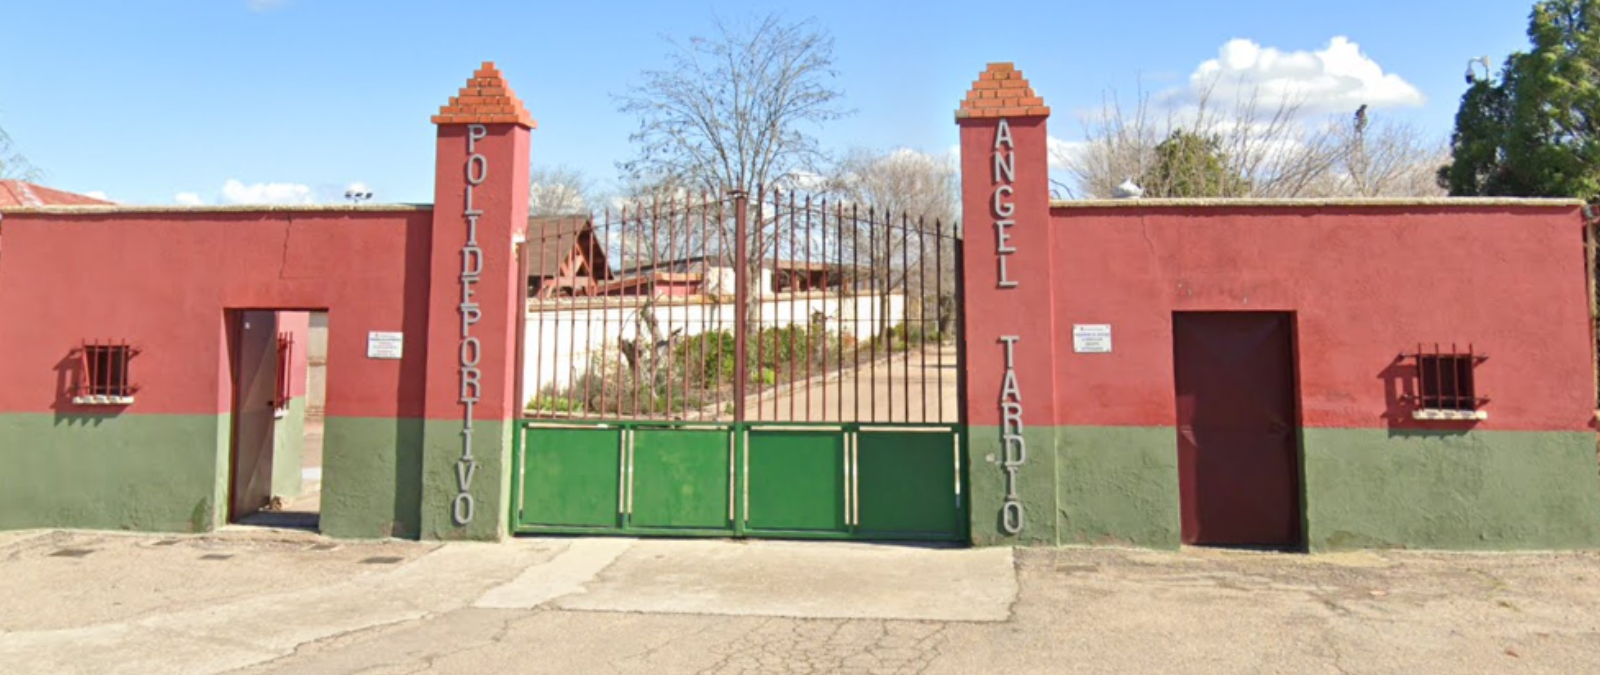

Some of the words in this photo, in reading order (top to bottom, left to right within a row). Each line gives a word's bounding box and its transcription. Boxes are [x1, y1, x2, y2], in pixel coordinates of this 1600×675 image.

[994, 119, 1018, 287] ANGEL
[454, 124, 487, 525] POLIDEPORTIVO
[1000, 335, 1025, 533] TARDIO
